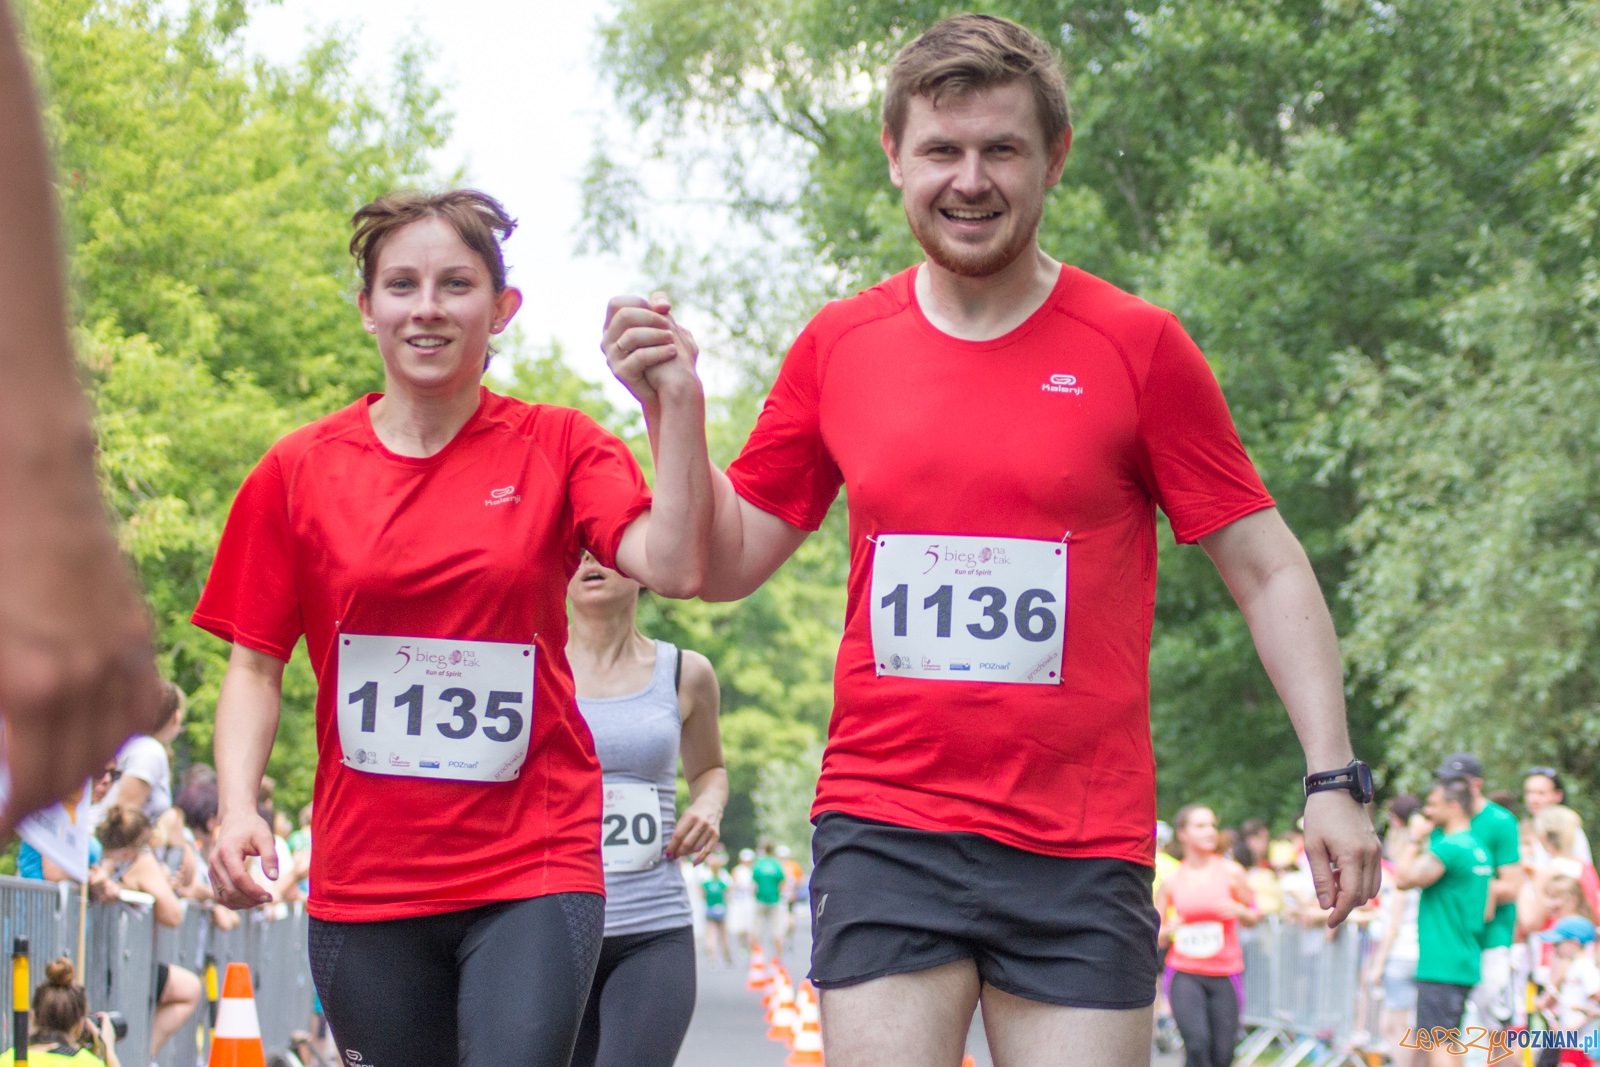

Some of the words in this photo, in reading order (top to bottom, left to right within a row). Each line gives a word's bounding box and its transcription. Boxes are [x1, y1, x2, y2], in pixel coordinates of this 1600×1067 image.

[923, 544, 940, 575] 5
[944, 546, 977, 568] bieg
[881, 583, 1057, 643] 1136
[394, 645, 411, 674] 5
[415, 647, 448, 669] bieg
[348, 681, 523, 742] 1135
